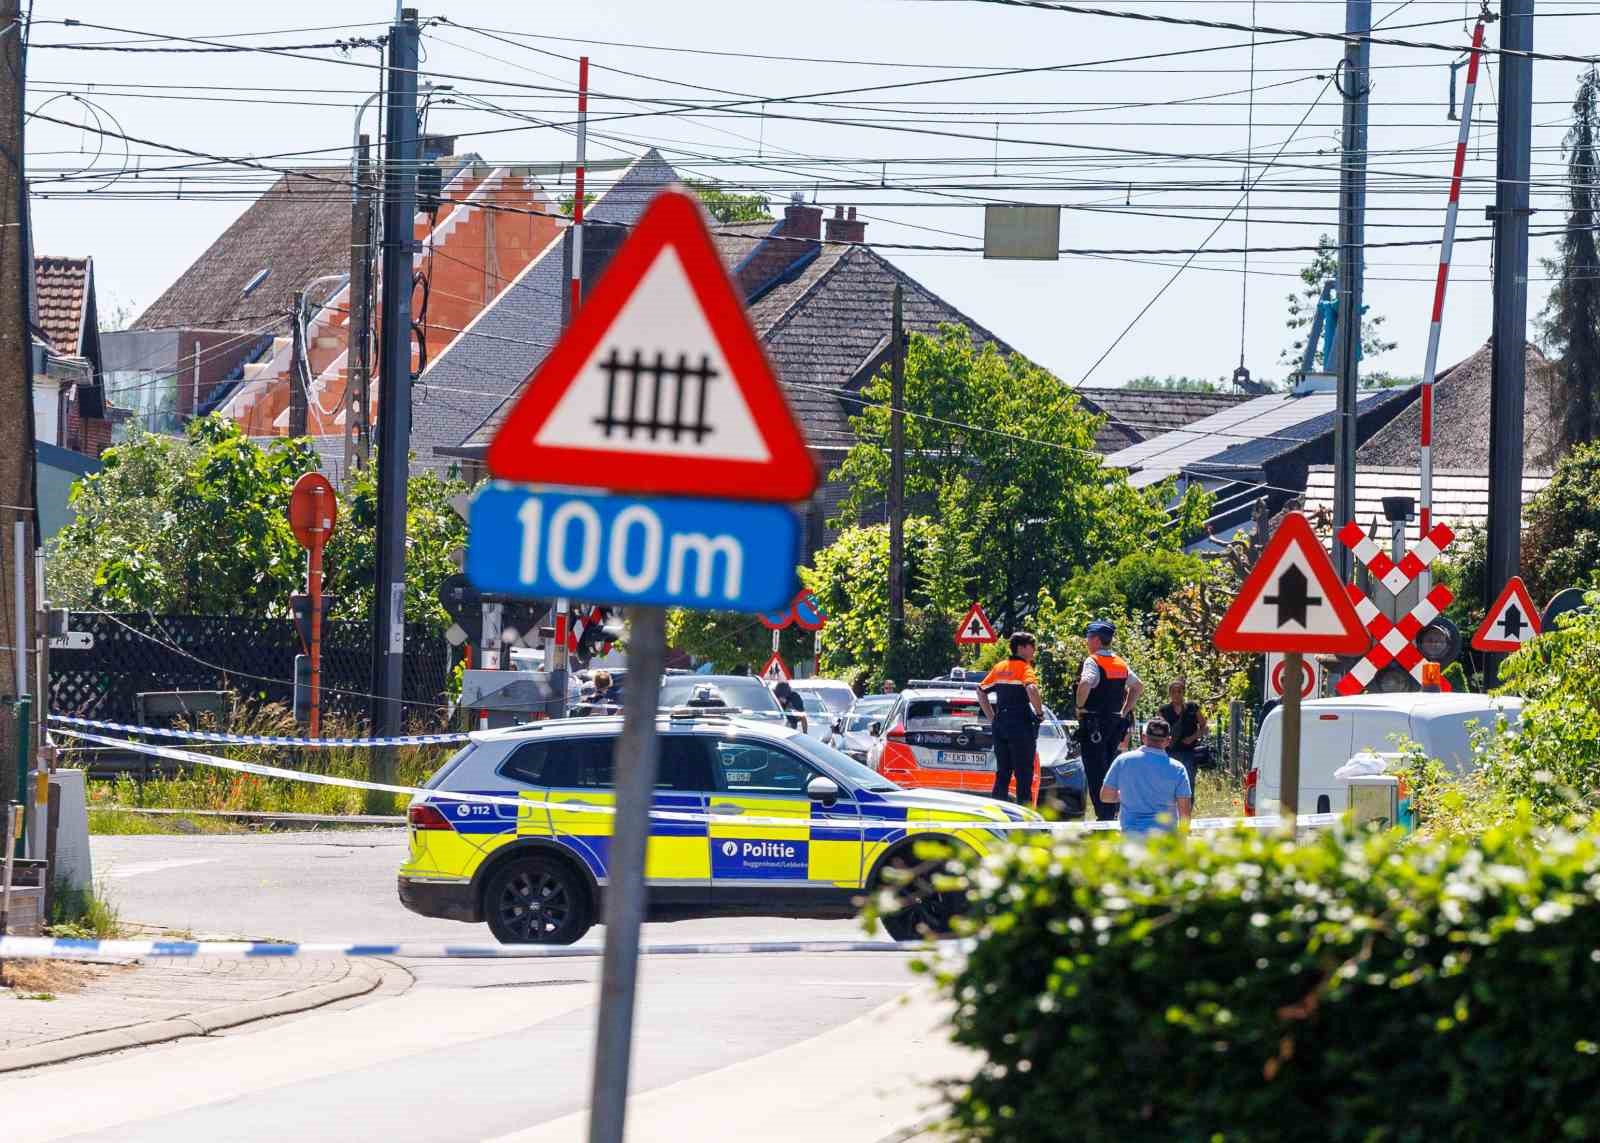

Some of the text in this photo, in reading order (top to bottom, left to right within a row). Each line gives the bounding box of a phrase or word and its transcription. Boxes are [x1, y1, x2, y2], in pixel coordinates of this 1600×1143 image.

[517, 497, 743, 599] 100m
[472, 805, 490, 815] 112
[743, 842, 795, 858] Politie
